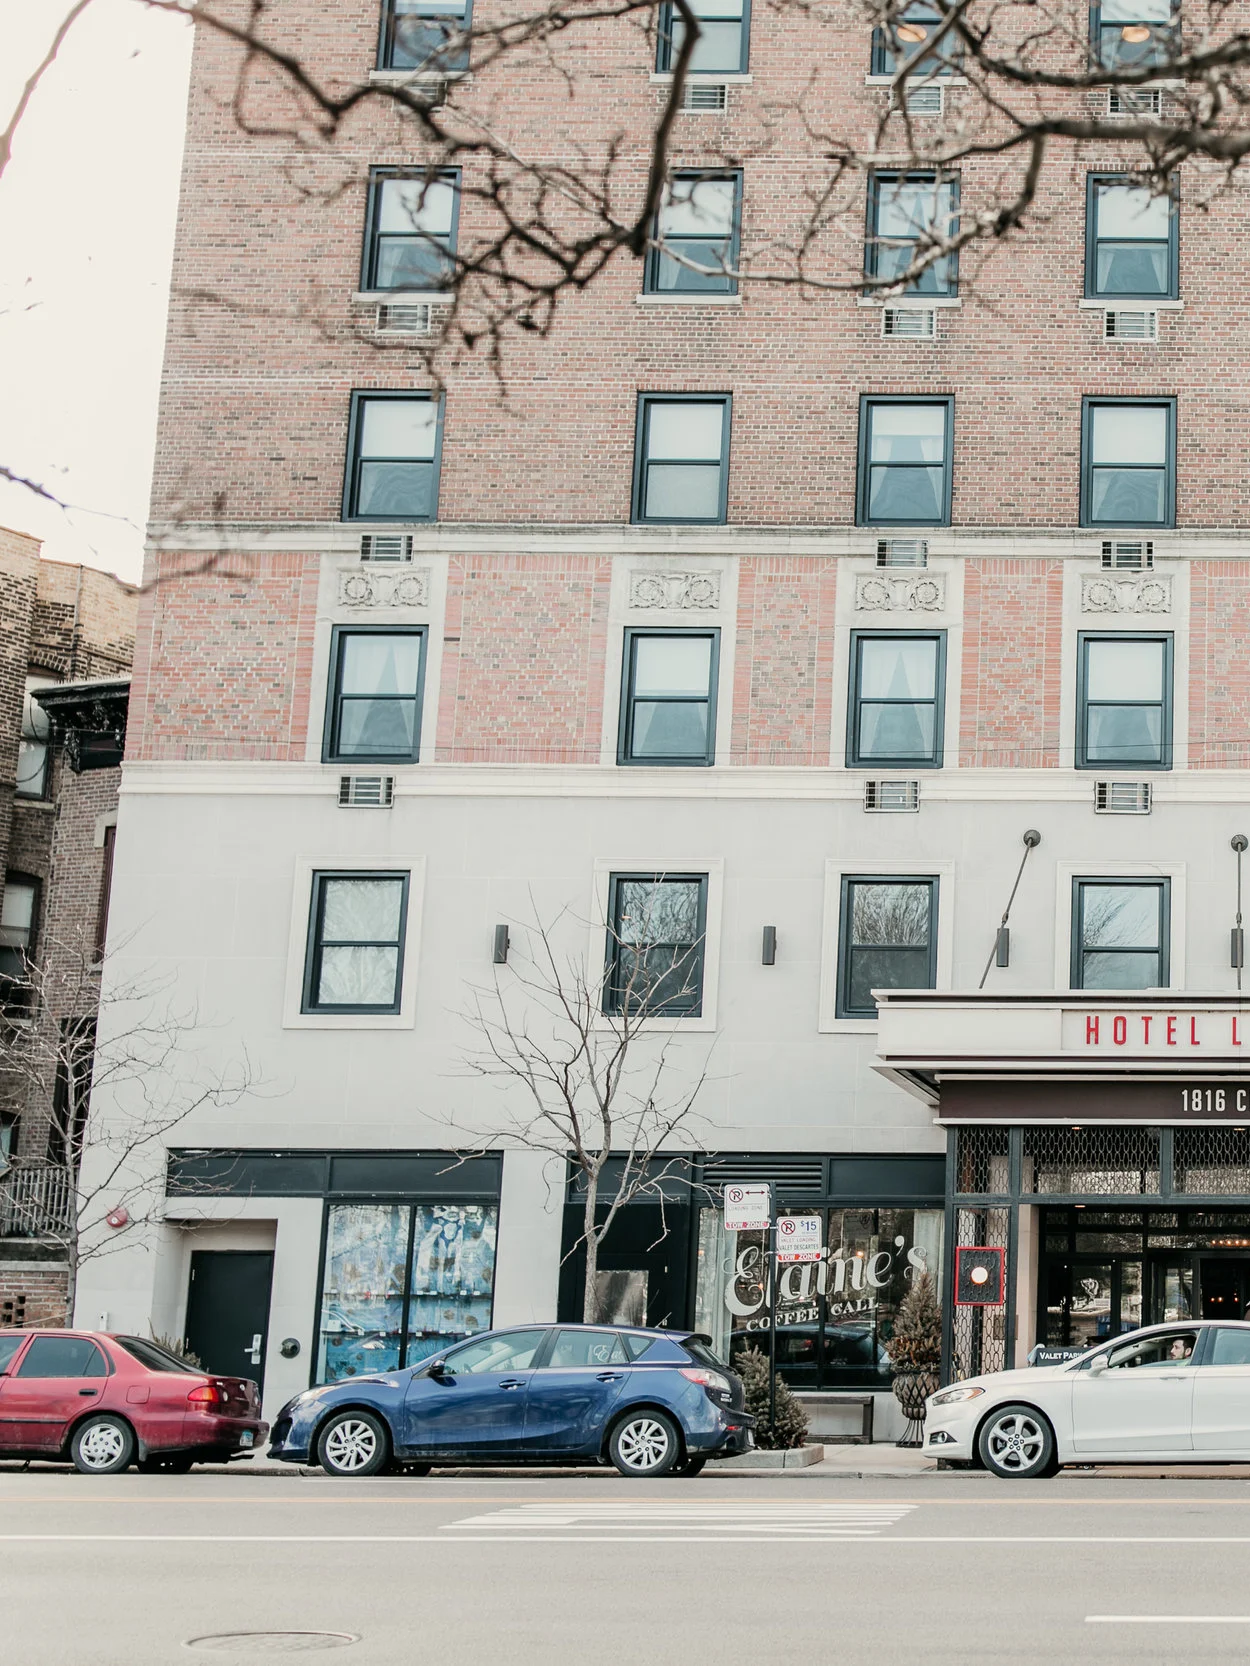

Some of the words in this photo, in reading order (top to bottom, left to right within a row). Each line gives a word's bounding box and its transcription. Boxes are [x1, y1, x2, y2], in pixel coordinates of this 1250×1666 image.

[1086, 1015, 1200, 1045] HOTEL
[1181, 1089, 1226, 1112] 1816
[748, 1221, 766, 1229] ZONE
[800, 1219, 817, 1231] $15
[799, 1252, 817, 1260] ZONE
[746, 1306, 819, 1332] COFFEE
[830, 1297, 880, 1316] CALL
